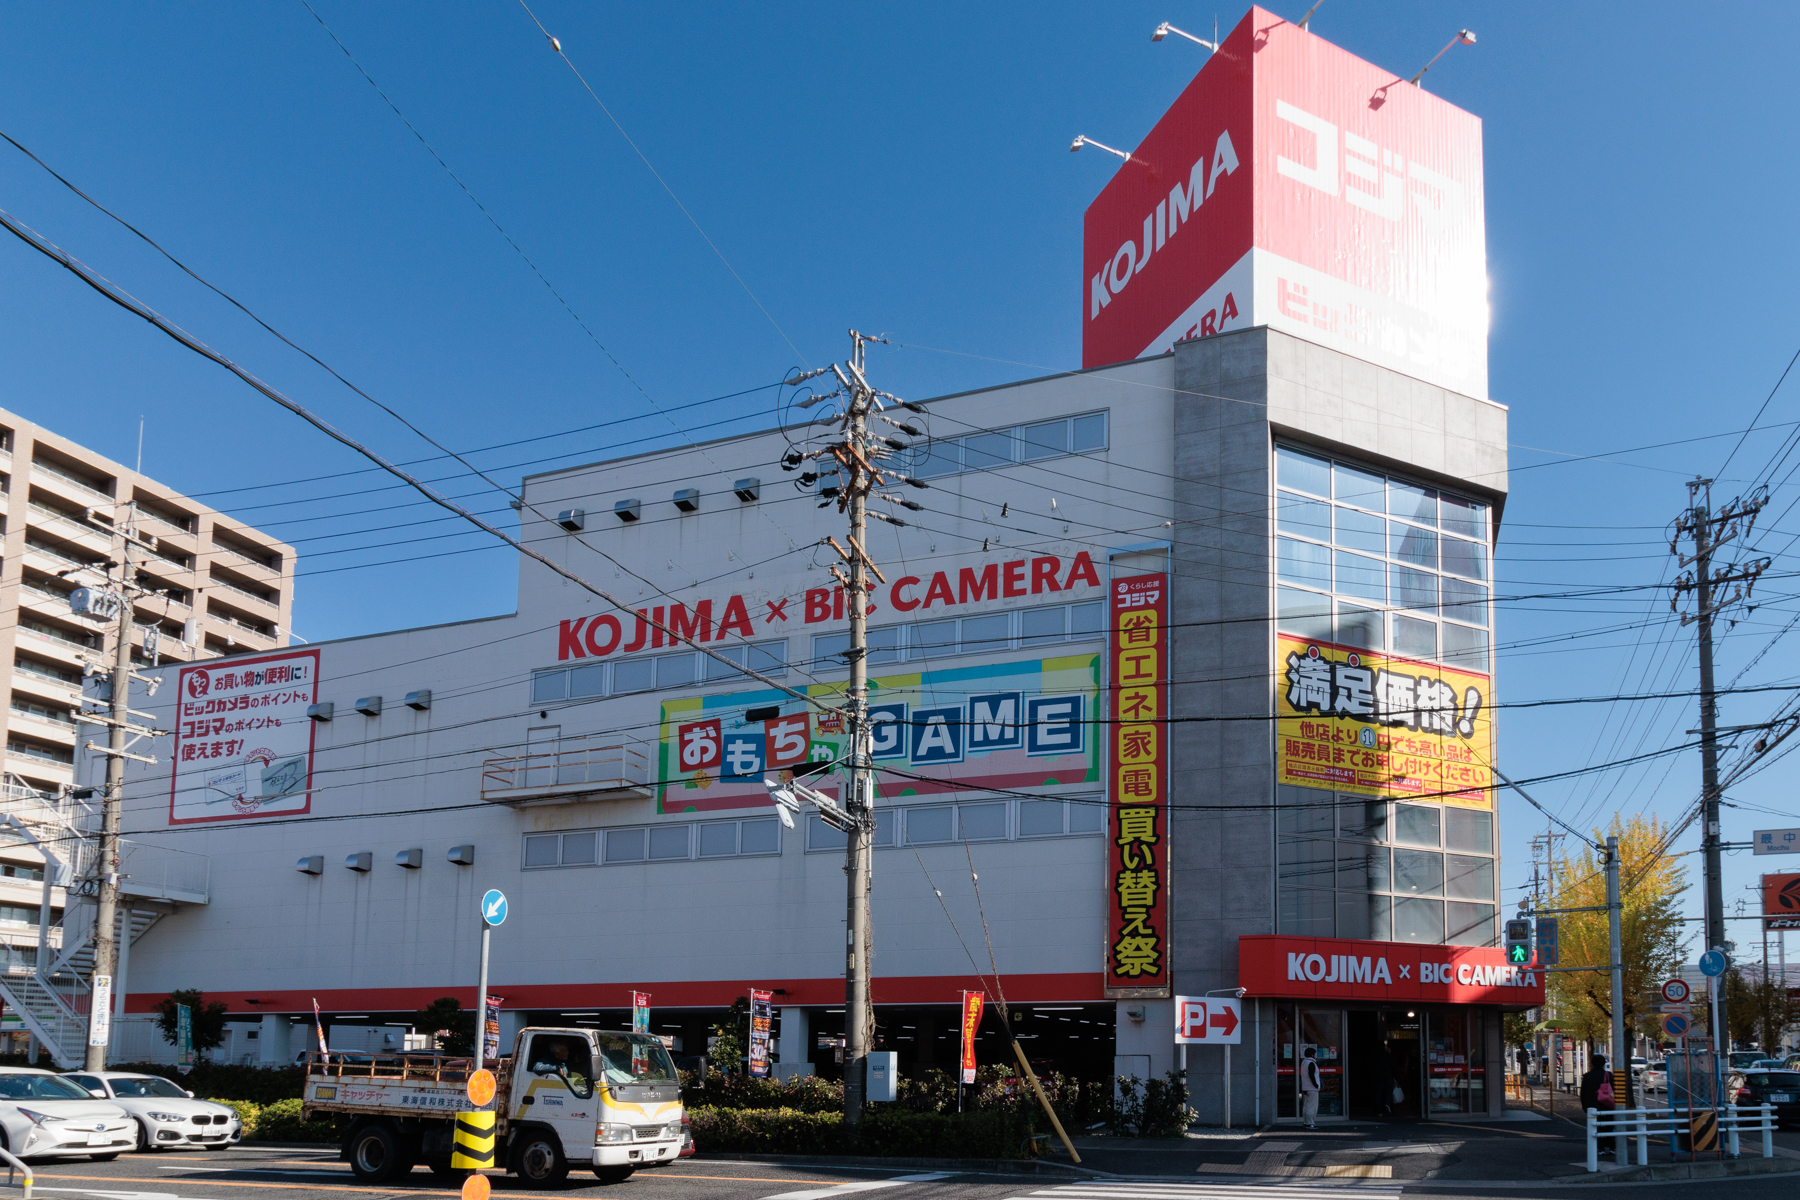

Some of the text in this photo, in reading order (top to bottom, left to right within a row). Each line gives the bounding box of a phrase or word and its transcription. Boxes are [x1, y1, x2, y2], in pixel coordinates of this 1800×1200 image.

[1276, 99, 1464, 242] コジマ
[1091, 129, 1240, 321] KOJIMA
[558, 595, 754, 661] KOJIMA
[890, 551, 1101, 612] CAMERA
[1117, 590, 1160, 608] コジマ
[183, 690, 309, 717] ビックカメラのポイントも
[1122, 614, 1154, 797] 省エネ家電
[181, 716, 282, 739] コジマのポイントも
[866, 698, 1073, 757] GAME
[181, 738, 245, 762] 使えます!
[682, 719, 836, 778] おもちゃ
[1115, 807, 1159, 976] 買い替え祭
[1287, 952, 1393, 985] KOJIMA
[1419, 962, 1454, 984] BIC
[1456, 964, 1538, 988] CAMERA
[1667, 985, 1684, 997] 50
[1184, 1005, 1205, 1037] P
[340, 1089, 391, 1102] キャッチャー
[401, 1095, 472, 1108] 東海信和株式会社
